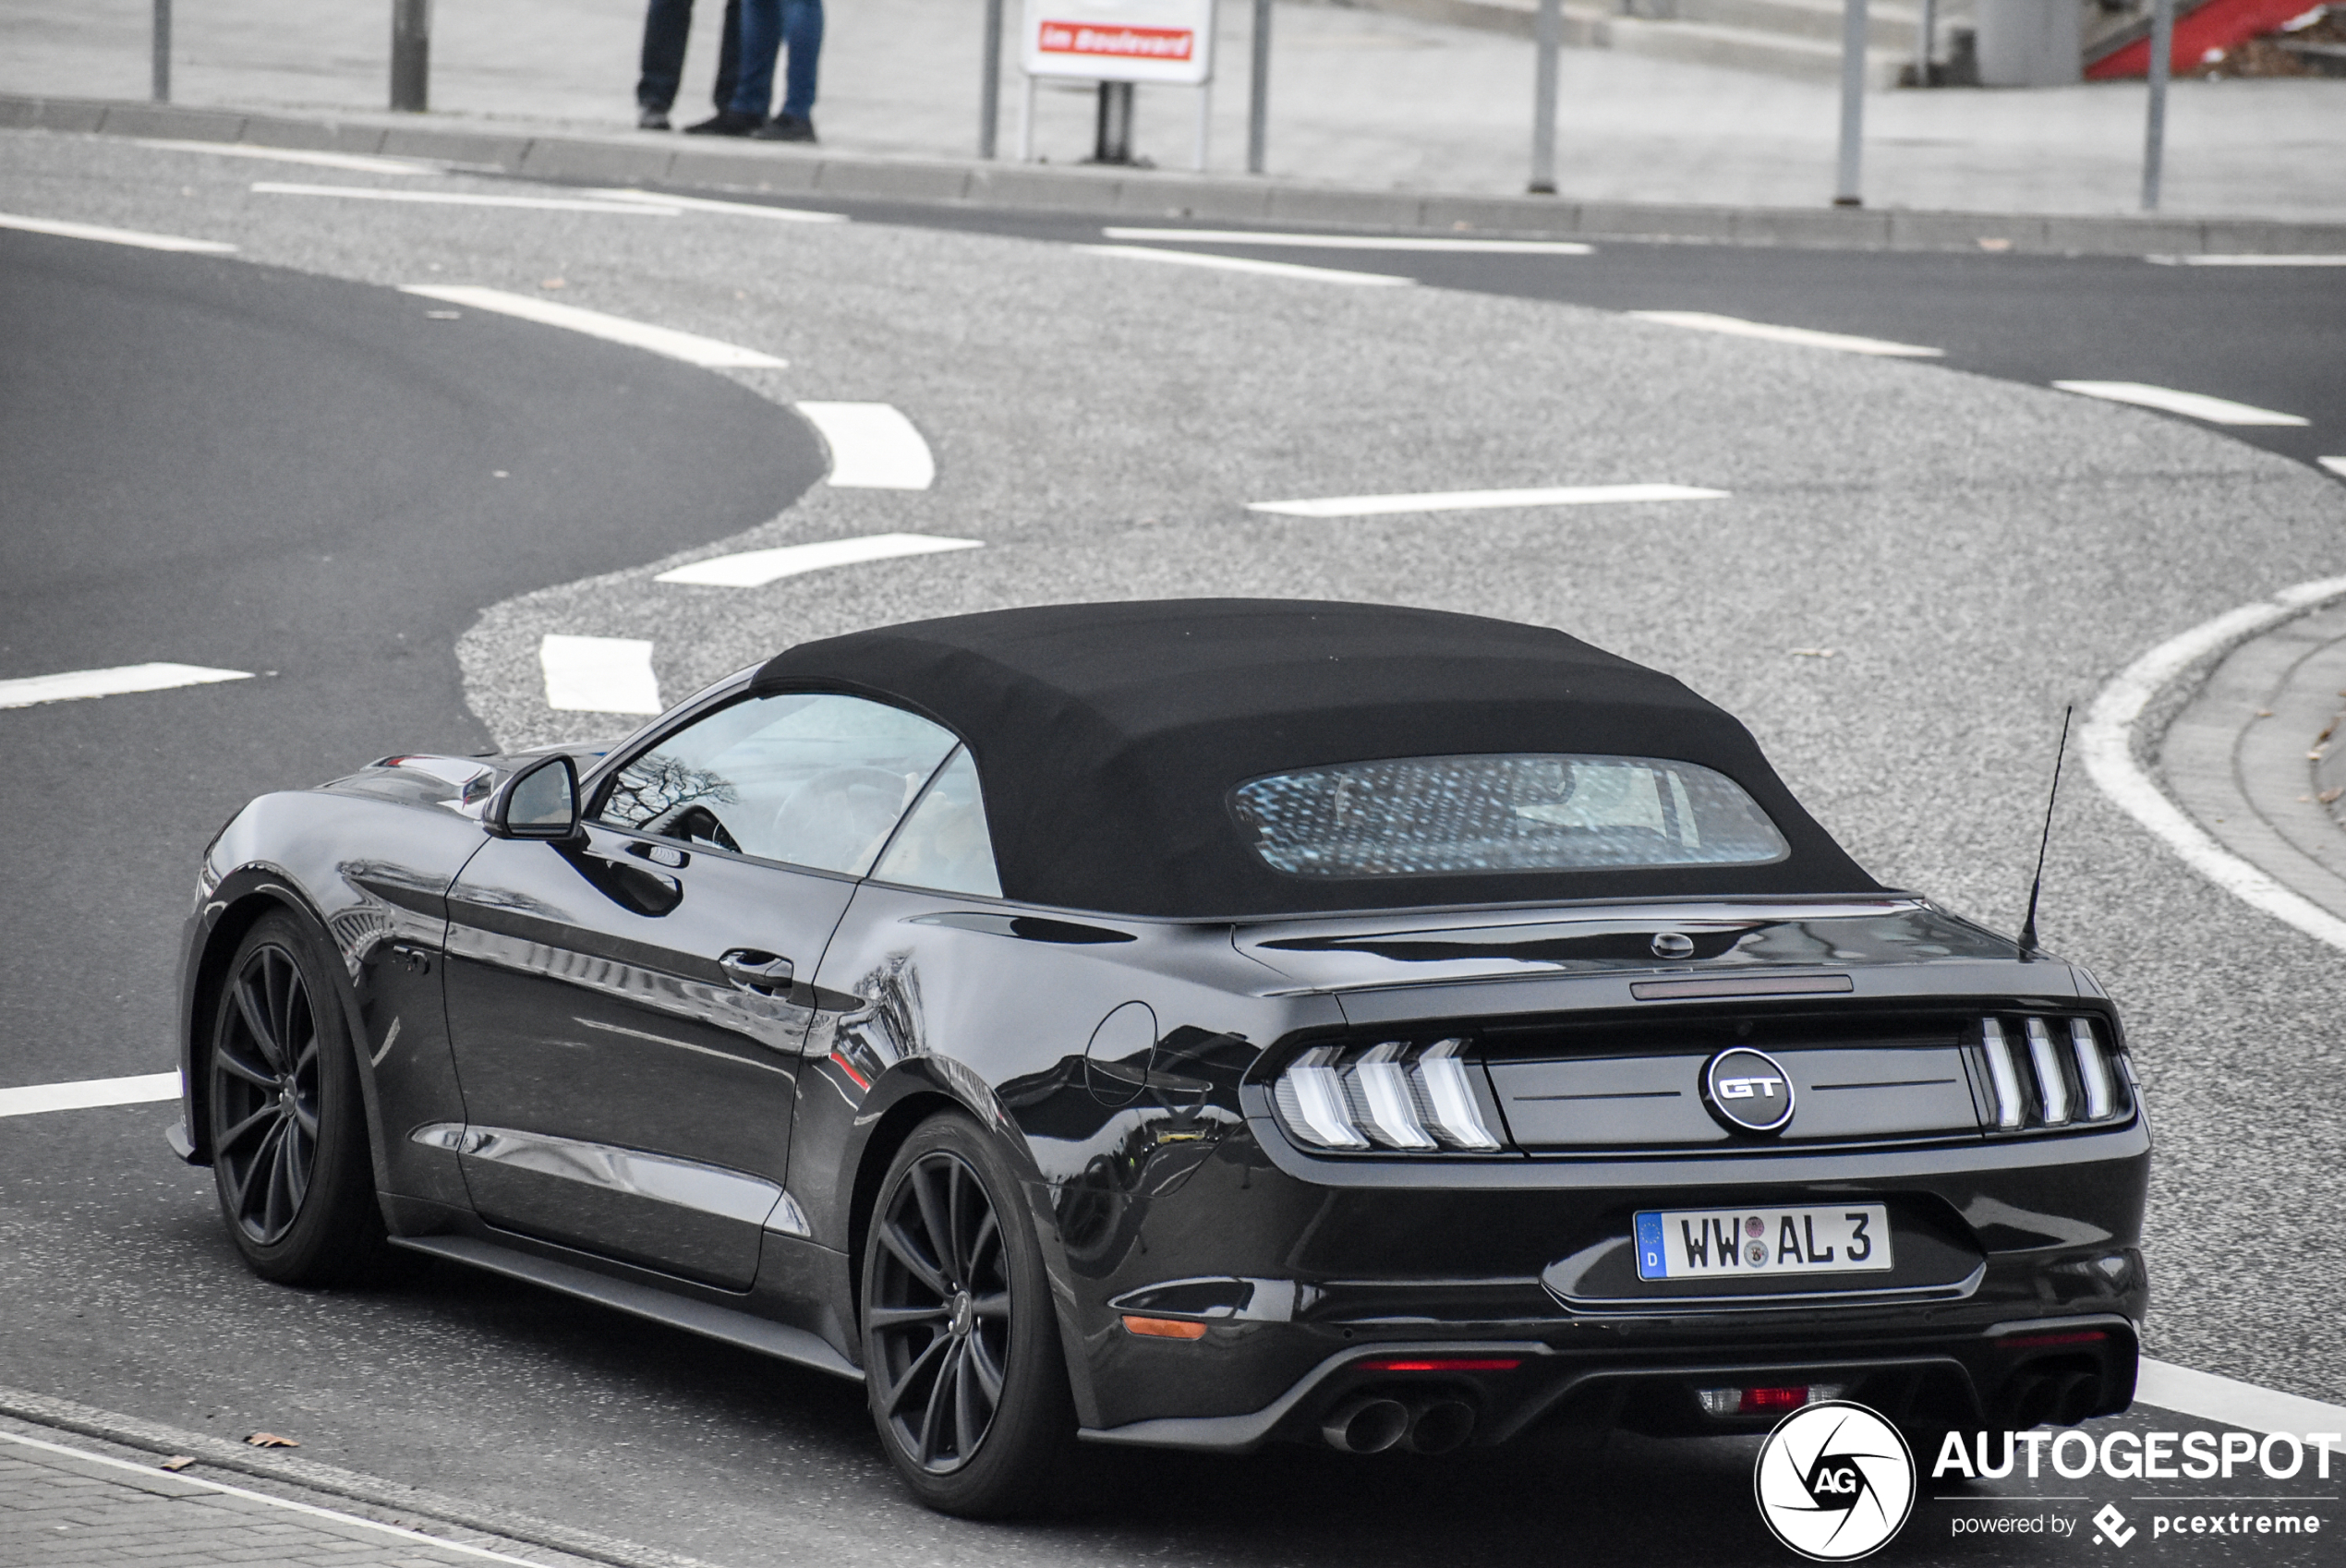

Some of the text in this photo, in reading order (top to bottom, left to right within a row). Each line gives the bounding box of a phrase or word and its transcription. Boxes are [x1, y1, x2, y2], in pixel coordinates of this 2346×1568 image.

[1719, 1077, 1783, 1099] GT
[1681, 1212, 1871, 1268] WW AL 3
[1647, 1252, 1658, 1267] D
